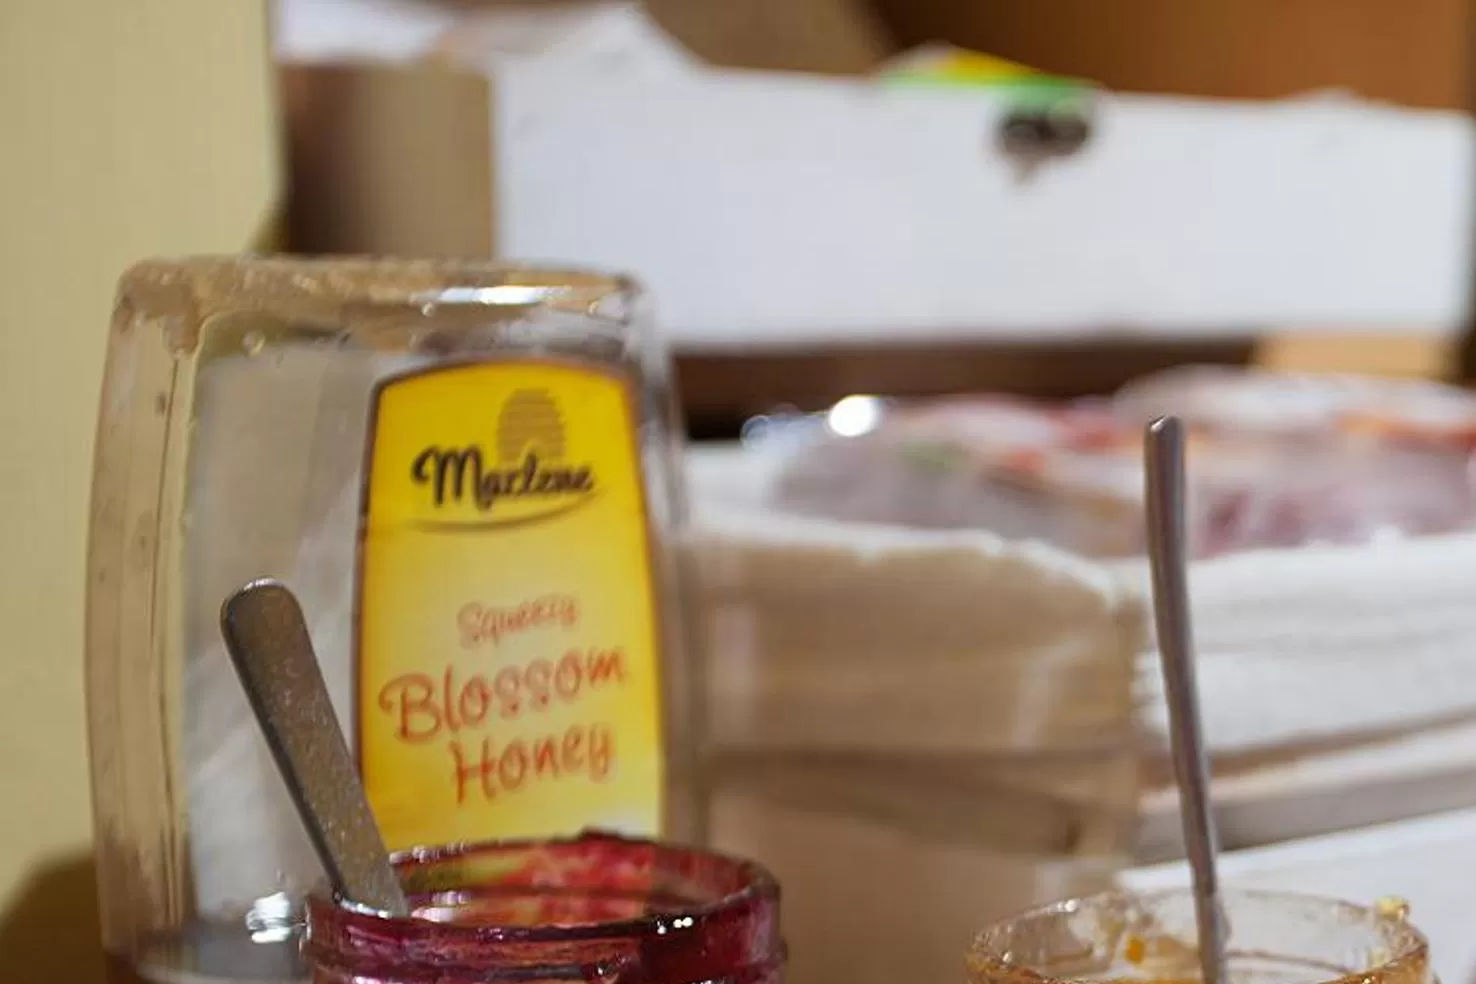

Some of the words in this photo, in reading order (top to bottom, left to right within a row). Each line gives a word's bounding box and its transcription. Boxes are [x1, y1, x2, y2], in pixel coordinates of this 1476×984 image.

[411, 443, 596, 512] Marlene
[378, 647, 626, 744] Blossom
[449, 723, 617, 805] Honey
